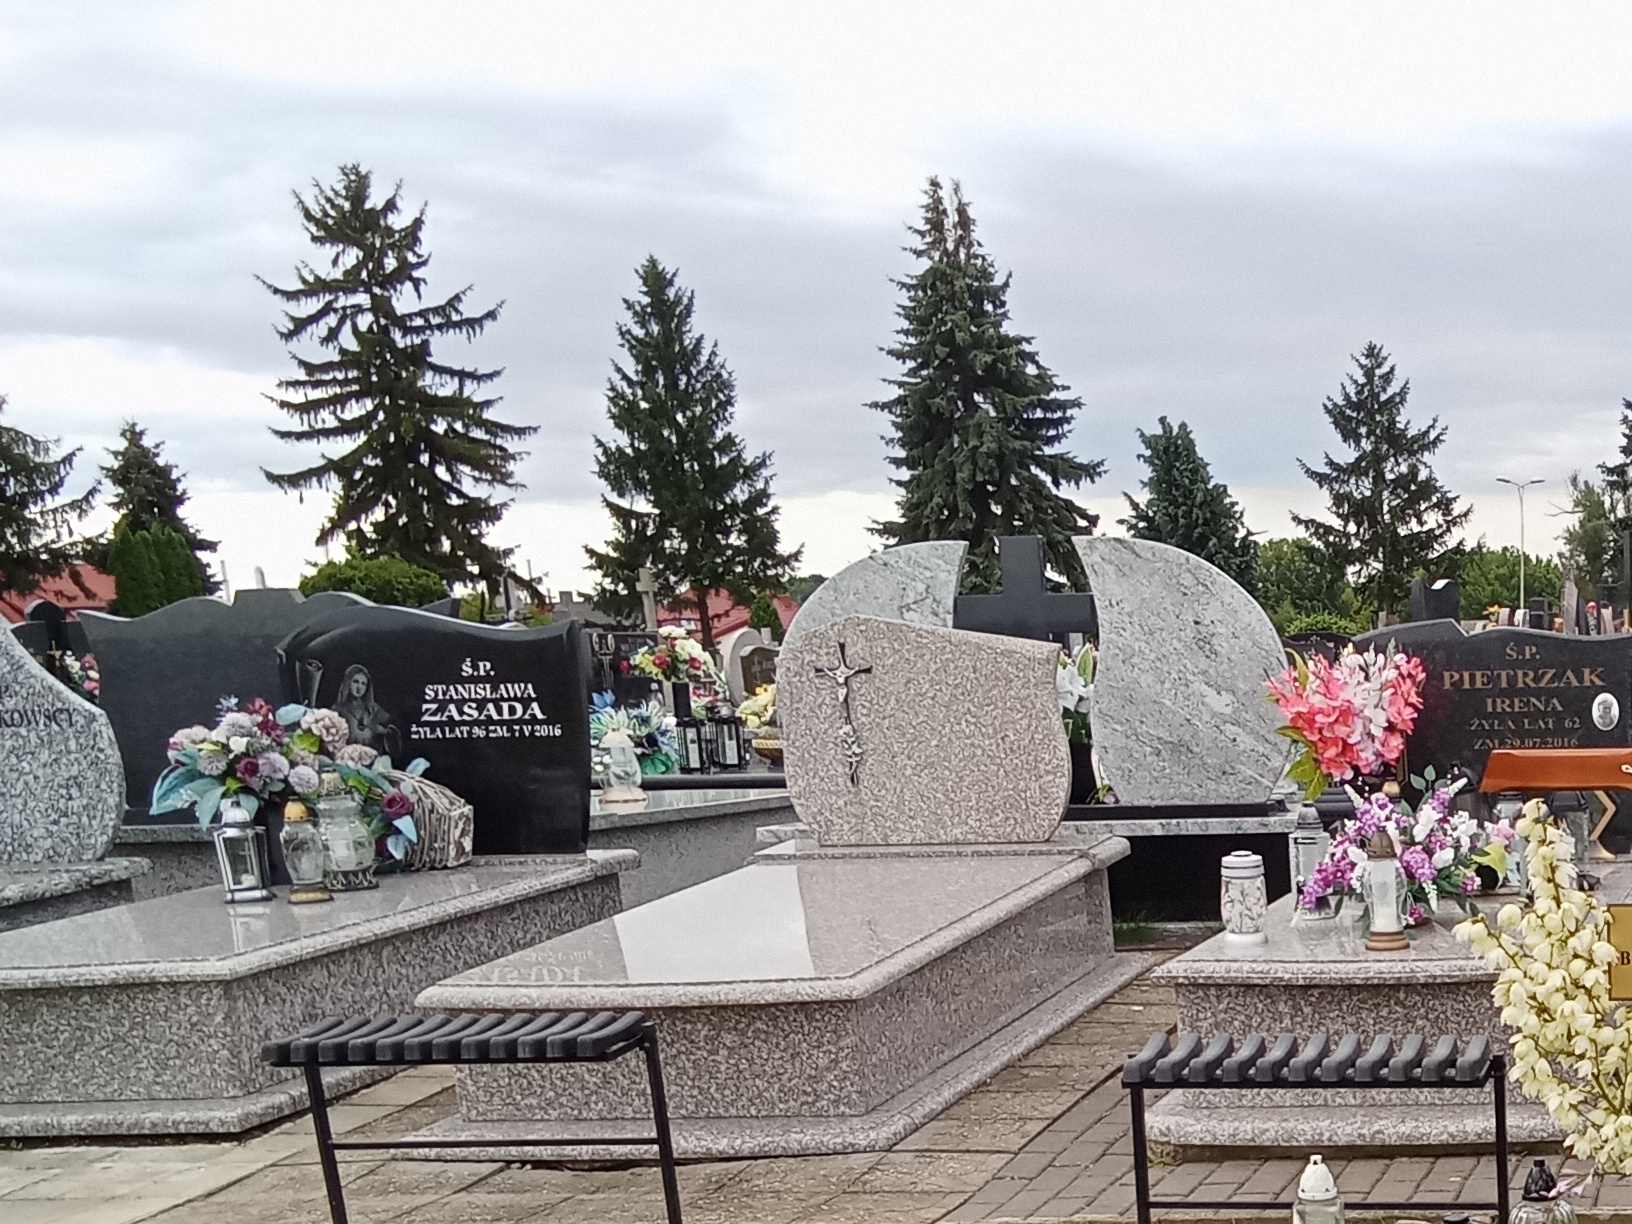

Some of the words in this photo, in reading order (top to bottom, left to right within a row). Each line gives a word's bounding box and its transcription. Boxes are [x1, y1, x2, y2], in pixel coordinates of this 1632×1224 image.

[1505, 642, 1541, 660] Ś.P.
[460, 657, 495, 676] Ś.P.
[1442, 667, 1607, 690] PIETRZAK
[420, 701, 548, 722] ZASADA
[1485, 696, 1564, 713] IRENA
[445, 726, 470, 739] LAT
[471, 725, 487, 738] 96
[513, 725, 521, 737] 7
[521, 724, 532, 738] V
[533, 724, 562, 738] 2016
[1523, 718, 1556, 731] LAT
[1564, 717, 1581, 729] 62
